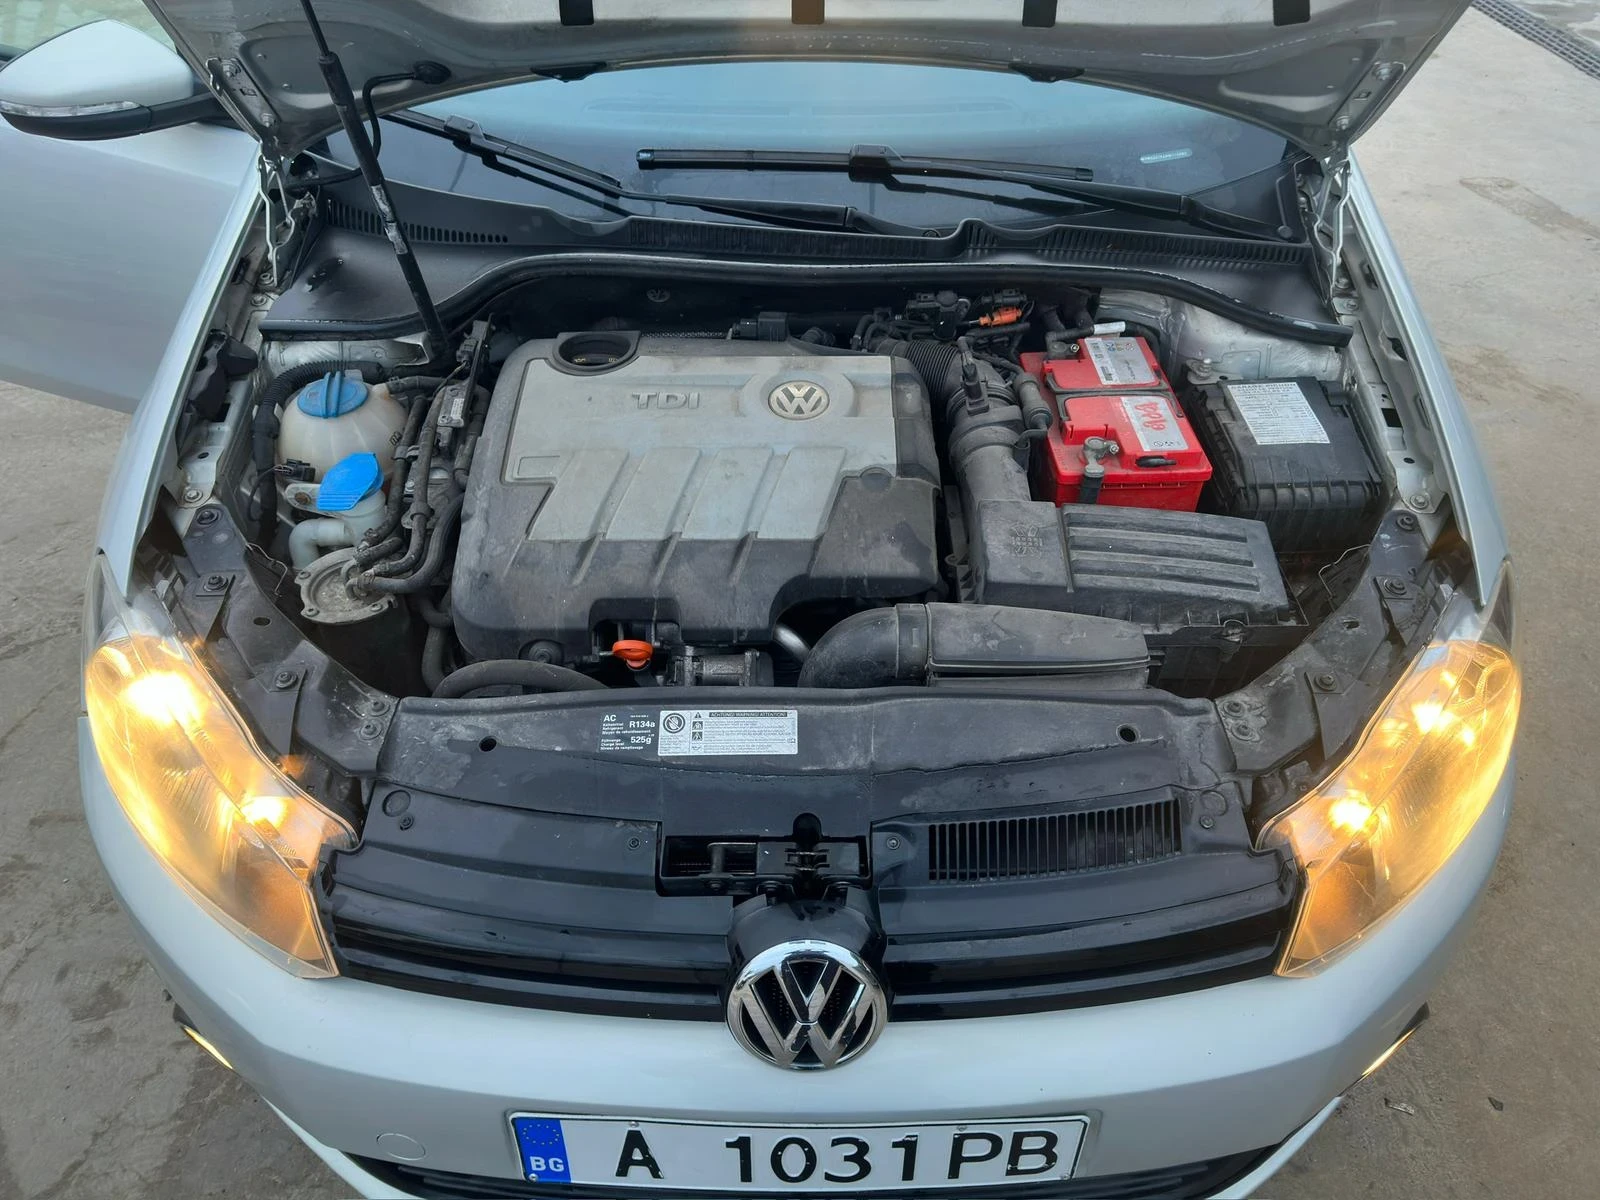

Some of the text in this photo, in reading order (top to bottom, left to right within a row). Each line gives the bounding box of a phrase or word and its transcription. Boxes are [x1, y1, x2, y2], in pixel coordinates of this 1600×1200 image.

[632, 391, 700, 409] TDI
[603, 714, 617, 722] AC
[629, 720, 656, 728] R134a
[630, 736, 652, 744] 525g
[615, 1129, 1058, 1183] A 1031 PB
[529, 1156, 564, 1172] BG
